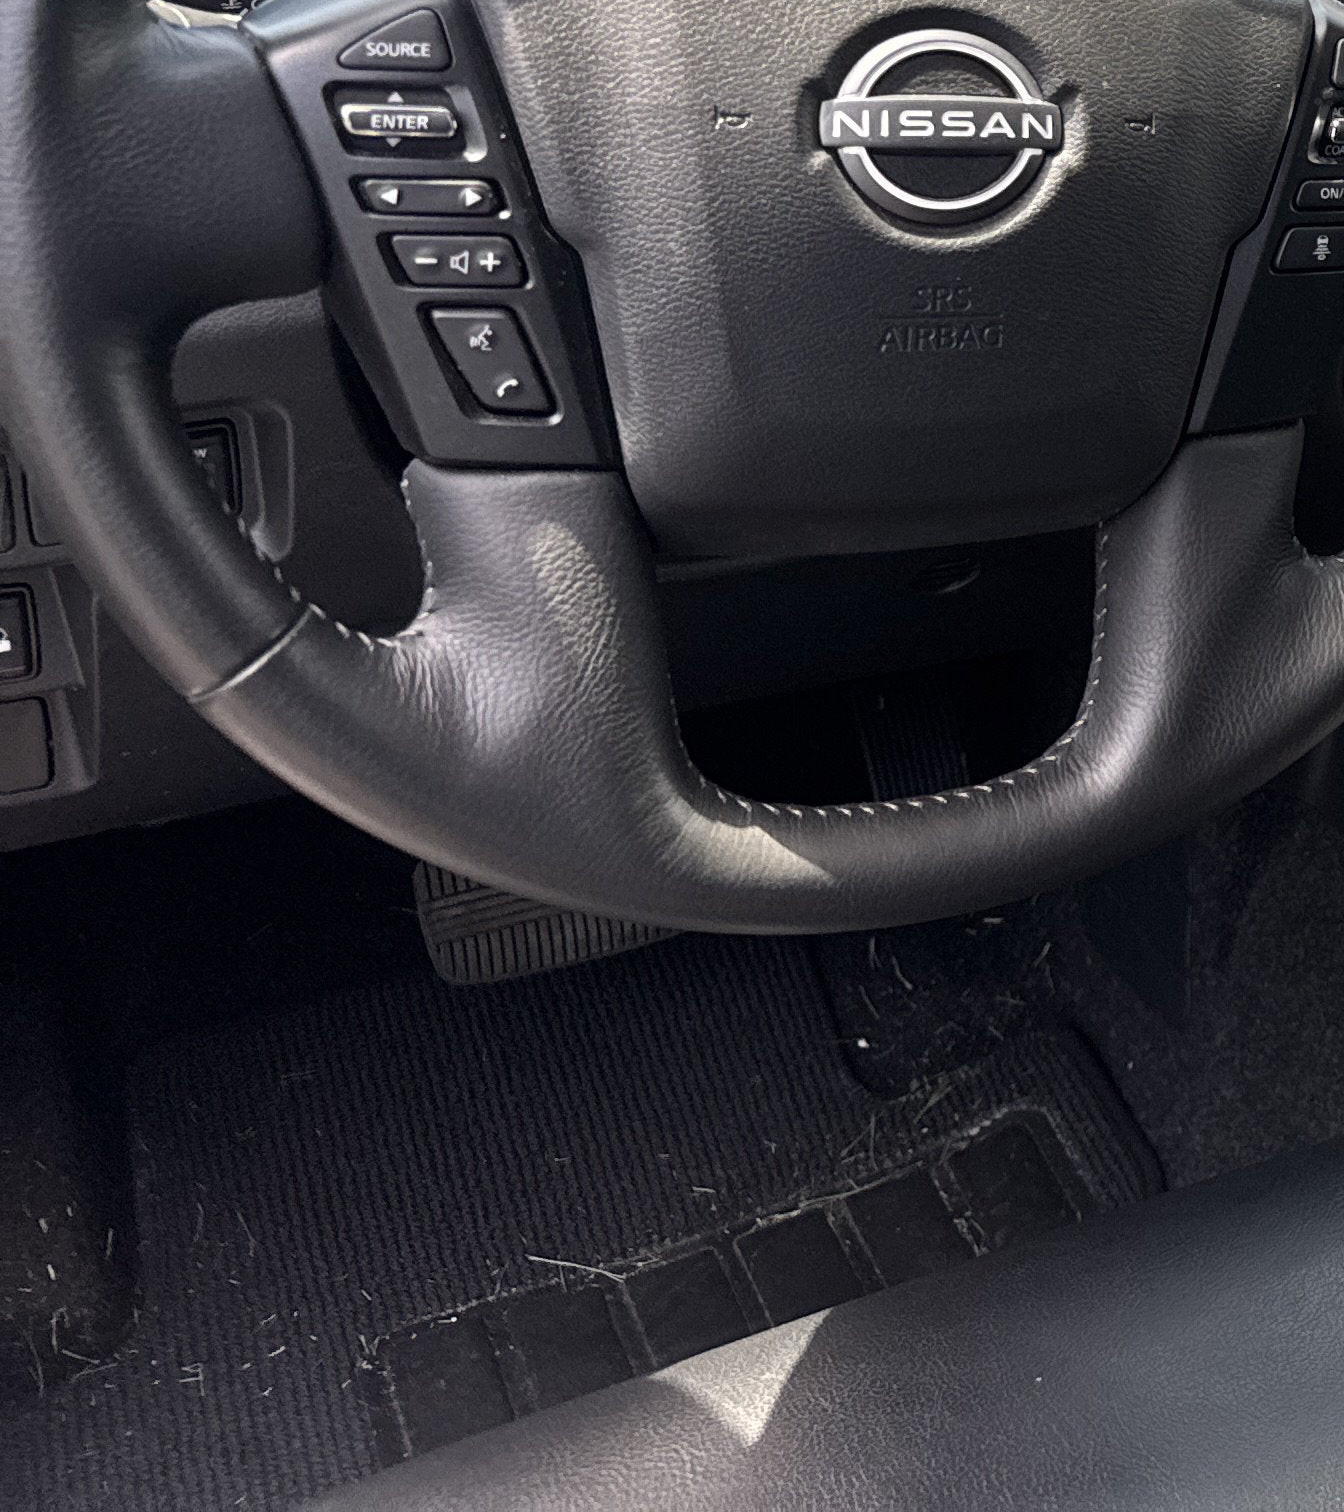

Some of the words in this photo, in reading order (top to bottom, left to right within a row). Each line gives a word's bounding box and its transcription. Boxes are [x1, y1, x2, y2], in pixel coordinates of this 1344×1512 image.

[365, 42, 431, 58] SOURCE
[370, 114, 429, 131] ENTER
[831, 108, 1054, 141] NISSAN
[911, 285, 972, 313] SRS
[880, 324, 1005, 353] AIRBAG
